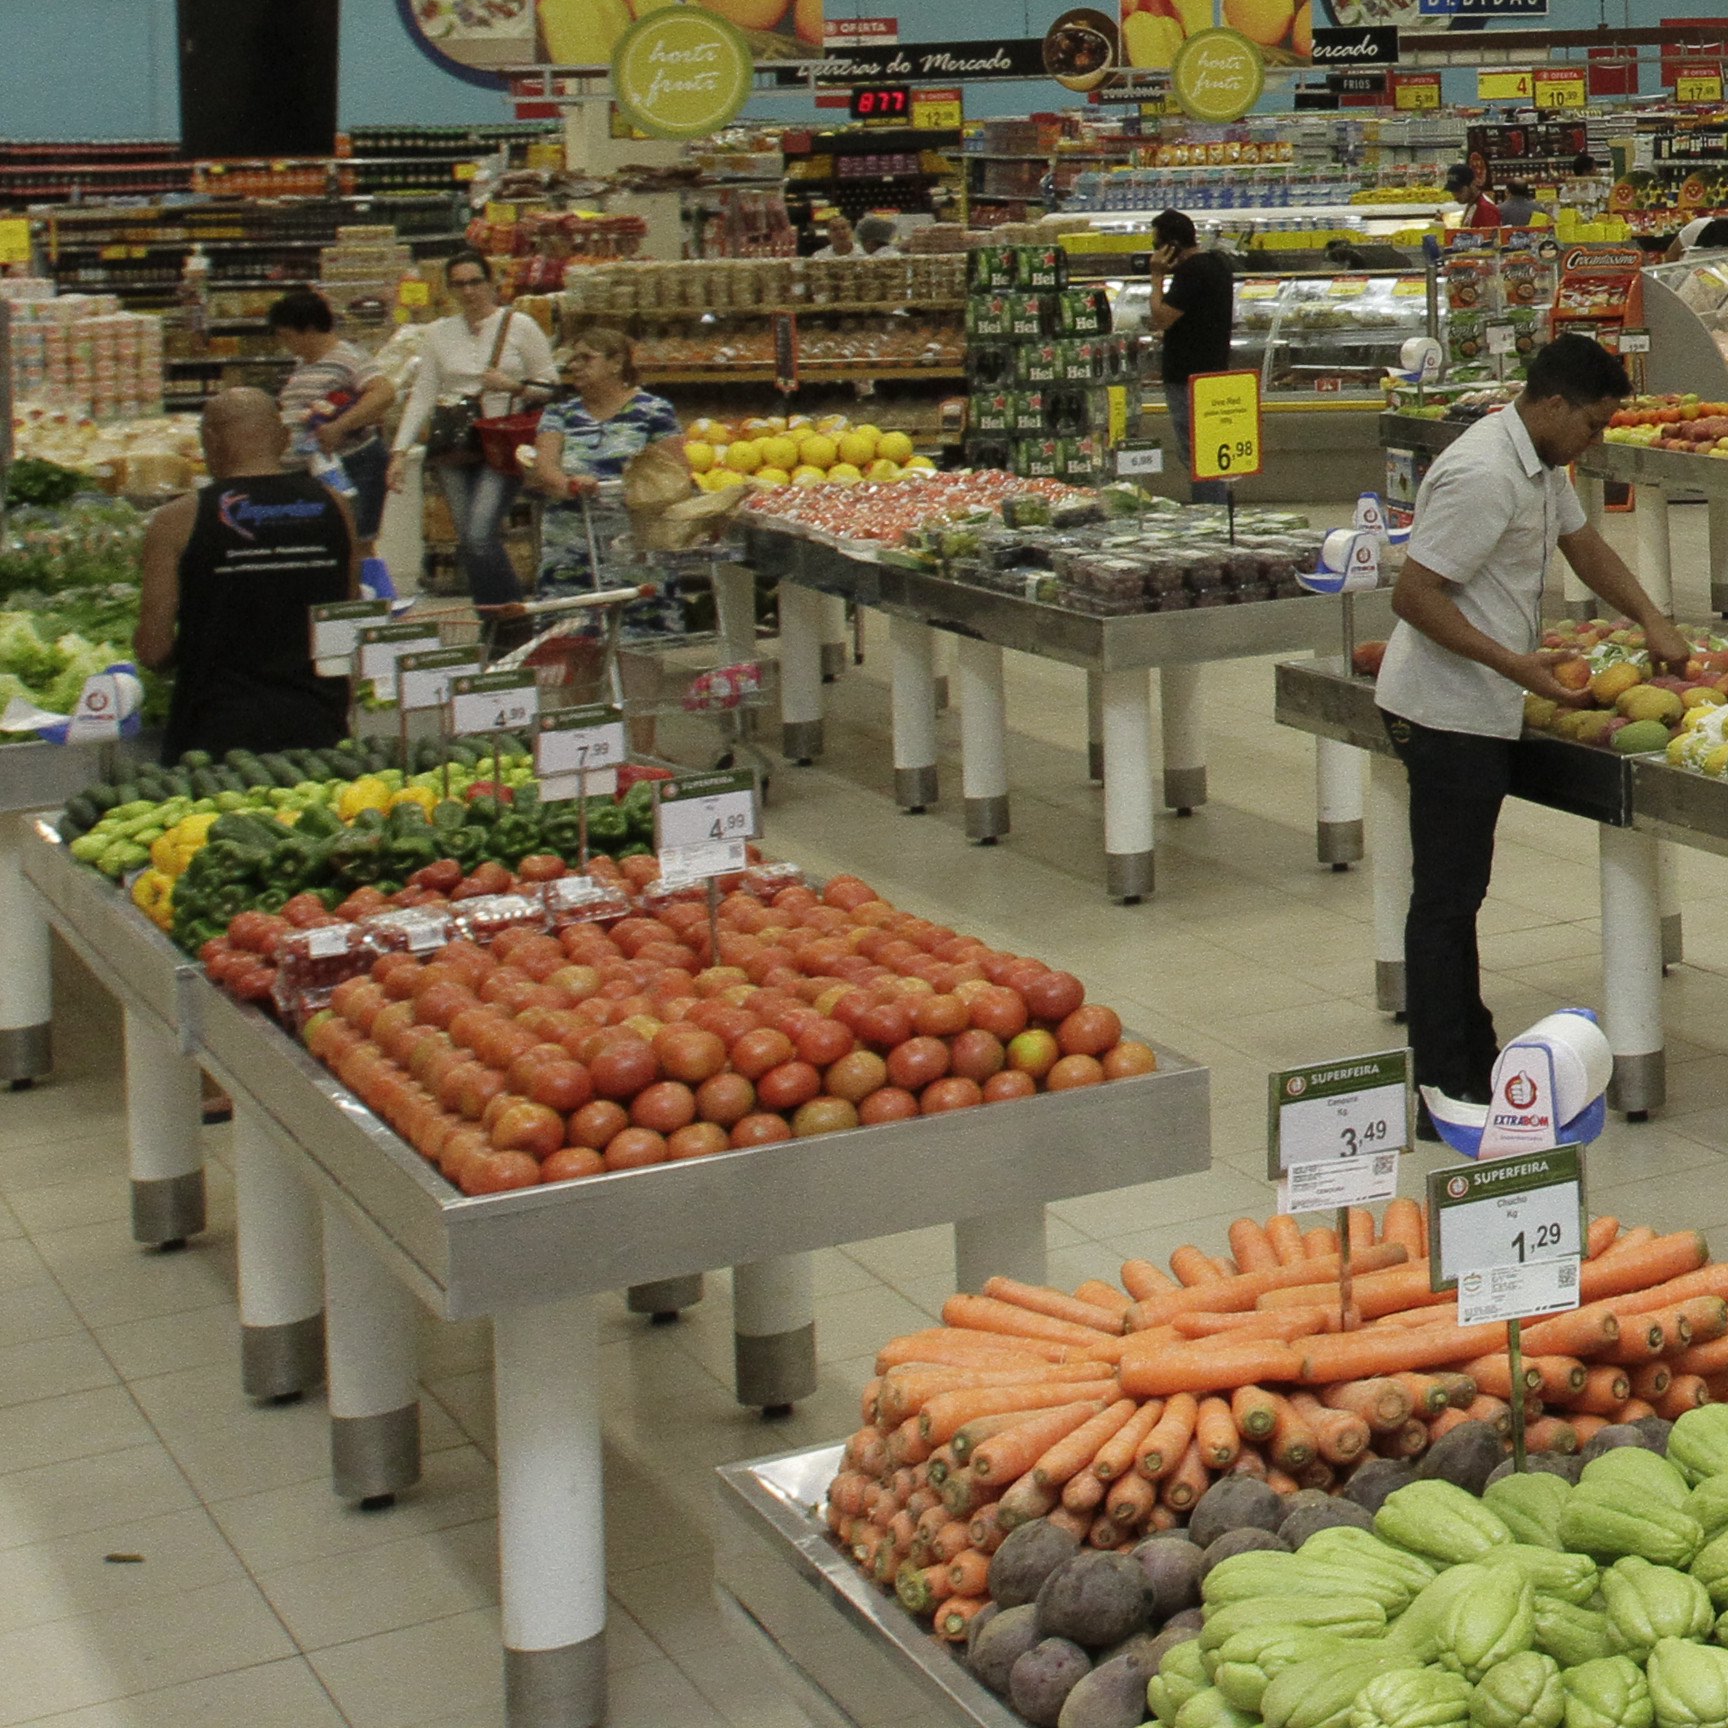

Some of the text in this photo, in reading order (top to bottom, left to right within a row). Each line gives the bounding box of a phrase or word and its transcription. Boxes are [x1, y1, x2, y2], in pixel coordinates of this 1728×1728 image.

[840, 23, 887, 33] OFERTA
[649, 40, 720, 63] horti
[1312, 34, 1379, 58] ercado
[886, 48, 1012, 73] do Mercado
[1198, 51, 1246, 71] horti
[645, 68, 720, 107] fruti
[1191, 71, 1241, 98] fruti
[1343, 78, 1371, 90] FRIOS
[858, 91, 906, 113] 877
[1217, 440, 1252, 471] 6,98
[576, 741, 610, 767] 7,99
[709, 813, 746, 840] 4,99
[1311, 1063, 1380, 1086] SUPERFEIRA
[1327, 1095, 1360, 1107] Cenoura
[1337, 1107, 1349, 1116] Kg
[1493, 1114, 1550, 1128] EXTRABOM
[1340, 1119, 1387, 1159] 3,49
[1473, 1160, 1550, 1186] SUPERFEIRA
[1506, 1209, 1519, 1220] Kg
[1511, 1221, 1562, 1264] 1,29
